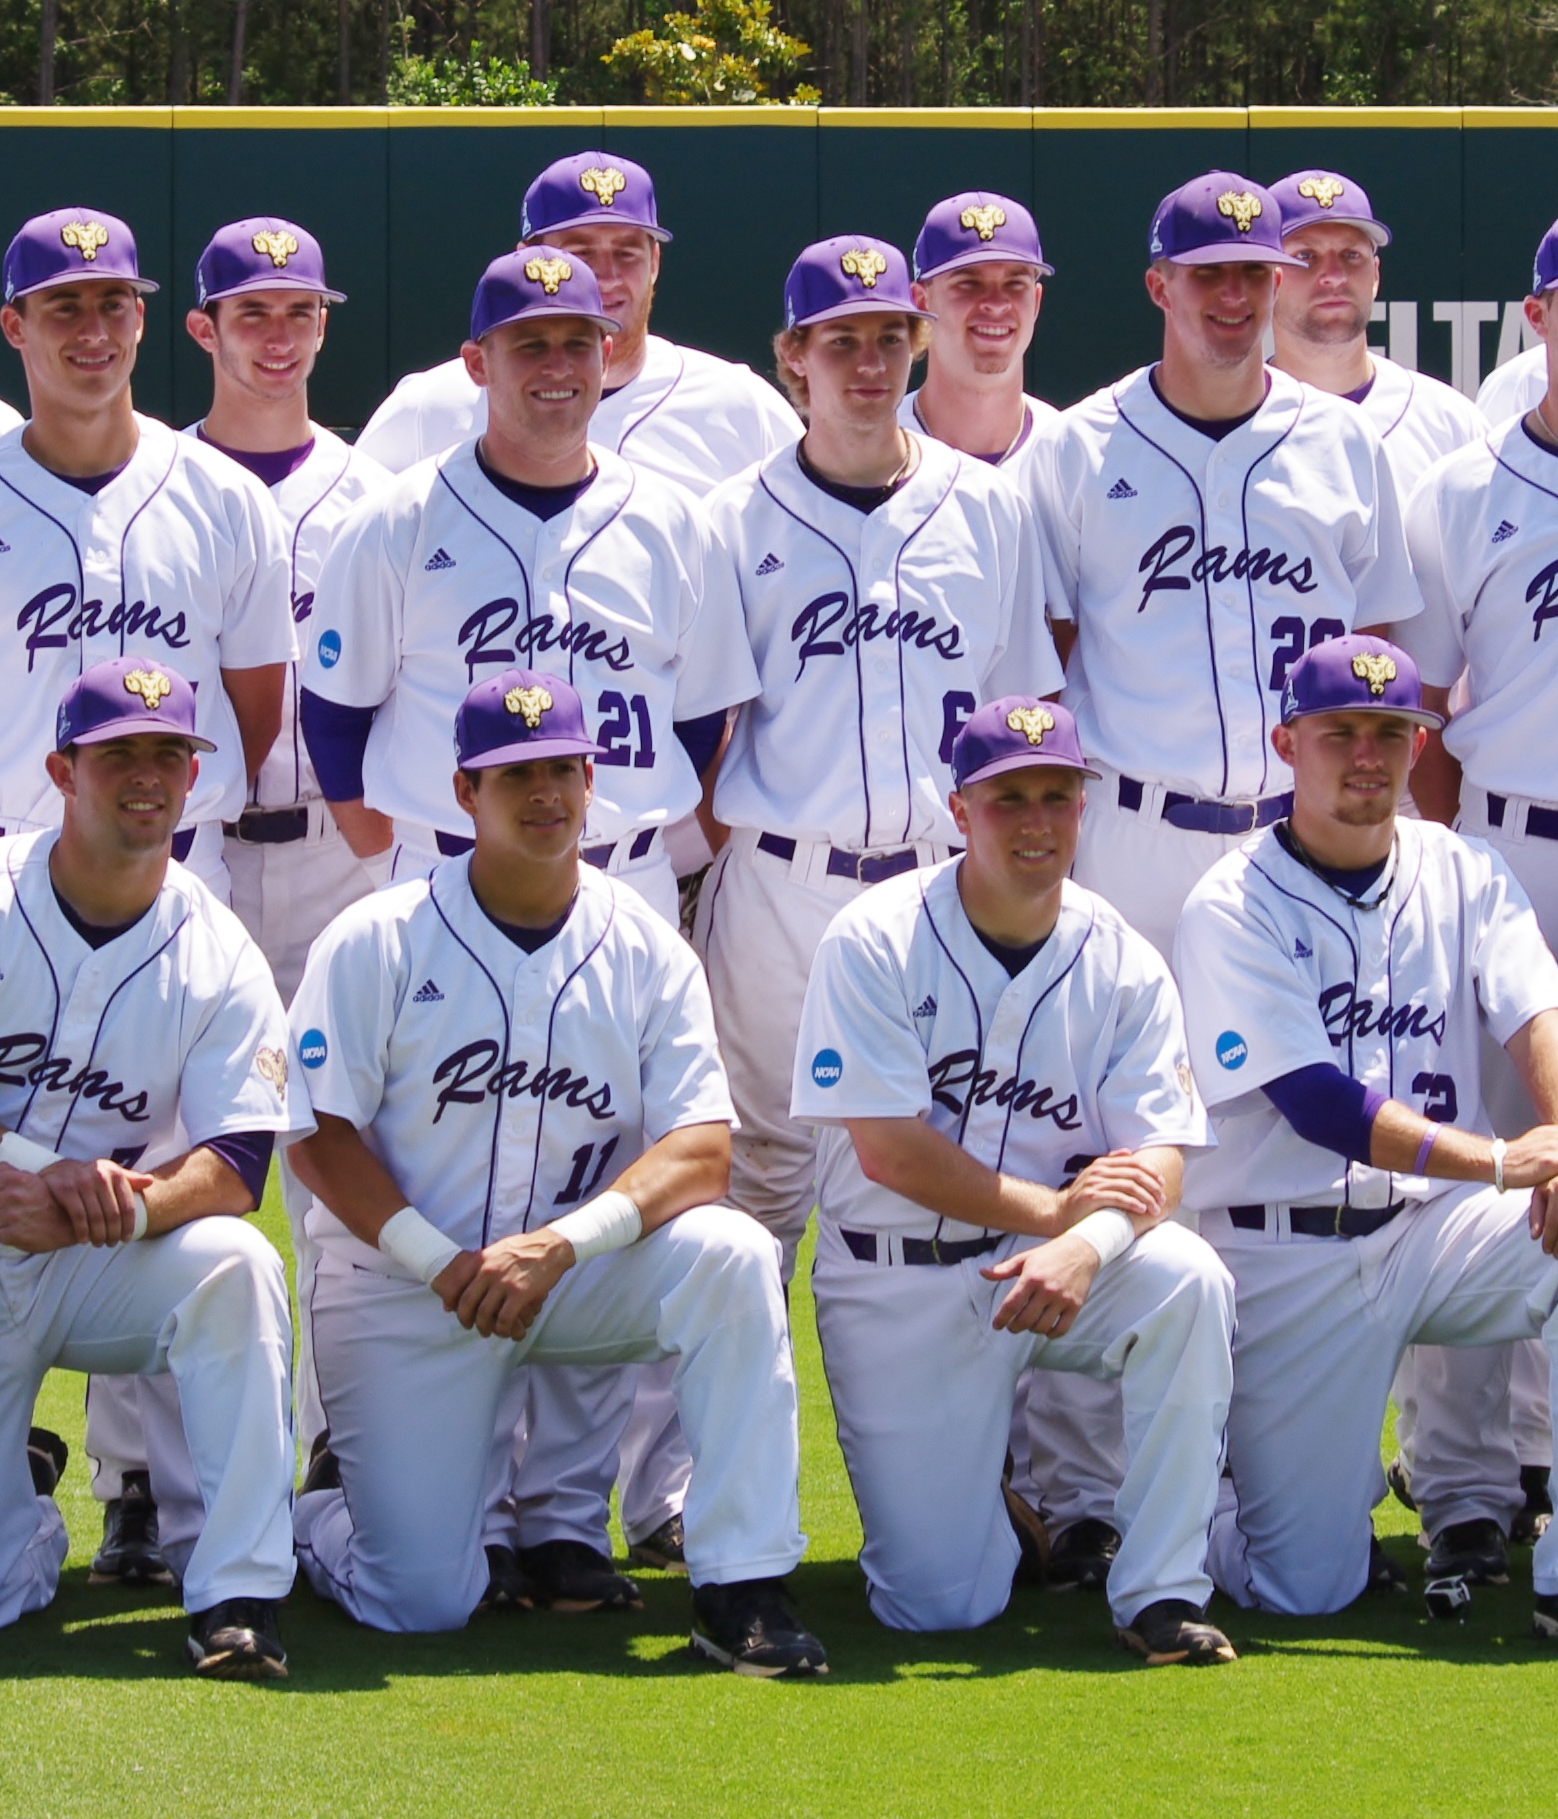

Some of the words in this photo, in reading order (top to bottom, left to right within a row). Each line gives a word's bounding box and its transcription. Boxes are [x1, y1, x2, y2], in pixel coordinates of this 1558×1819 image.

[1107, 490, 1138, 499] adidas
[425, 560, 456, 571] adidas
[756, 562, 784, 576] adidas
[1139, 525, 1319, 612] Rams
[17, 582, 190, 673] Rams
[457, 597, 634, 684] Rams
[791, 591, 964, 683] Rams
[595, 691, 657, 769] 21
[413, 993, 444, 1002] adidas
[303, 1045, 326, 1060] NCAA
[431, 1038, 616, 1124] Rams
[814, 1066, 840, 1079] NCAA
[1221, 1043, 1247, 1064] NCAA
[928, 1049, 1083, 1131] Rams
[553, 1133, 620, 1205] 11
